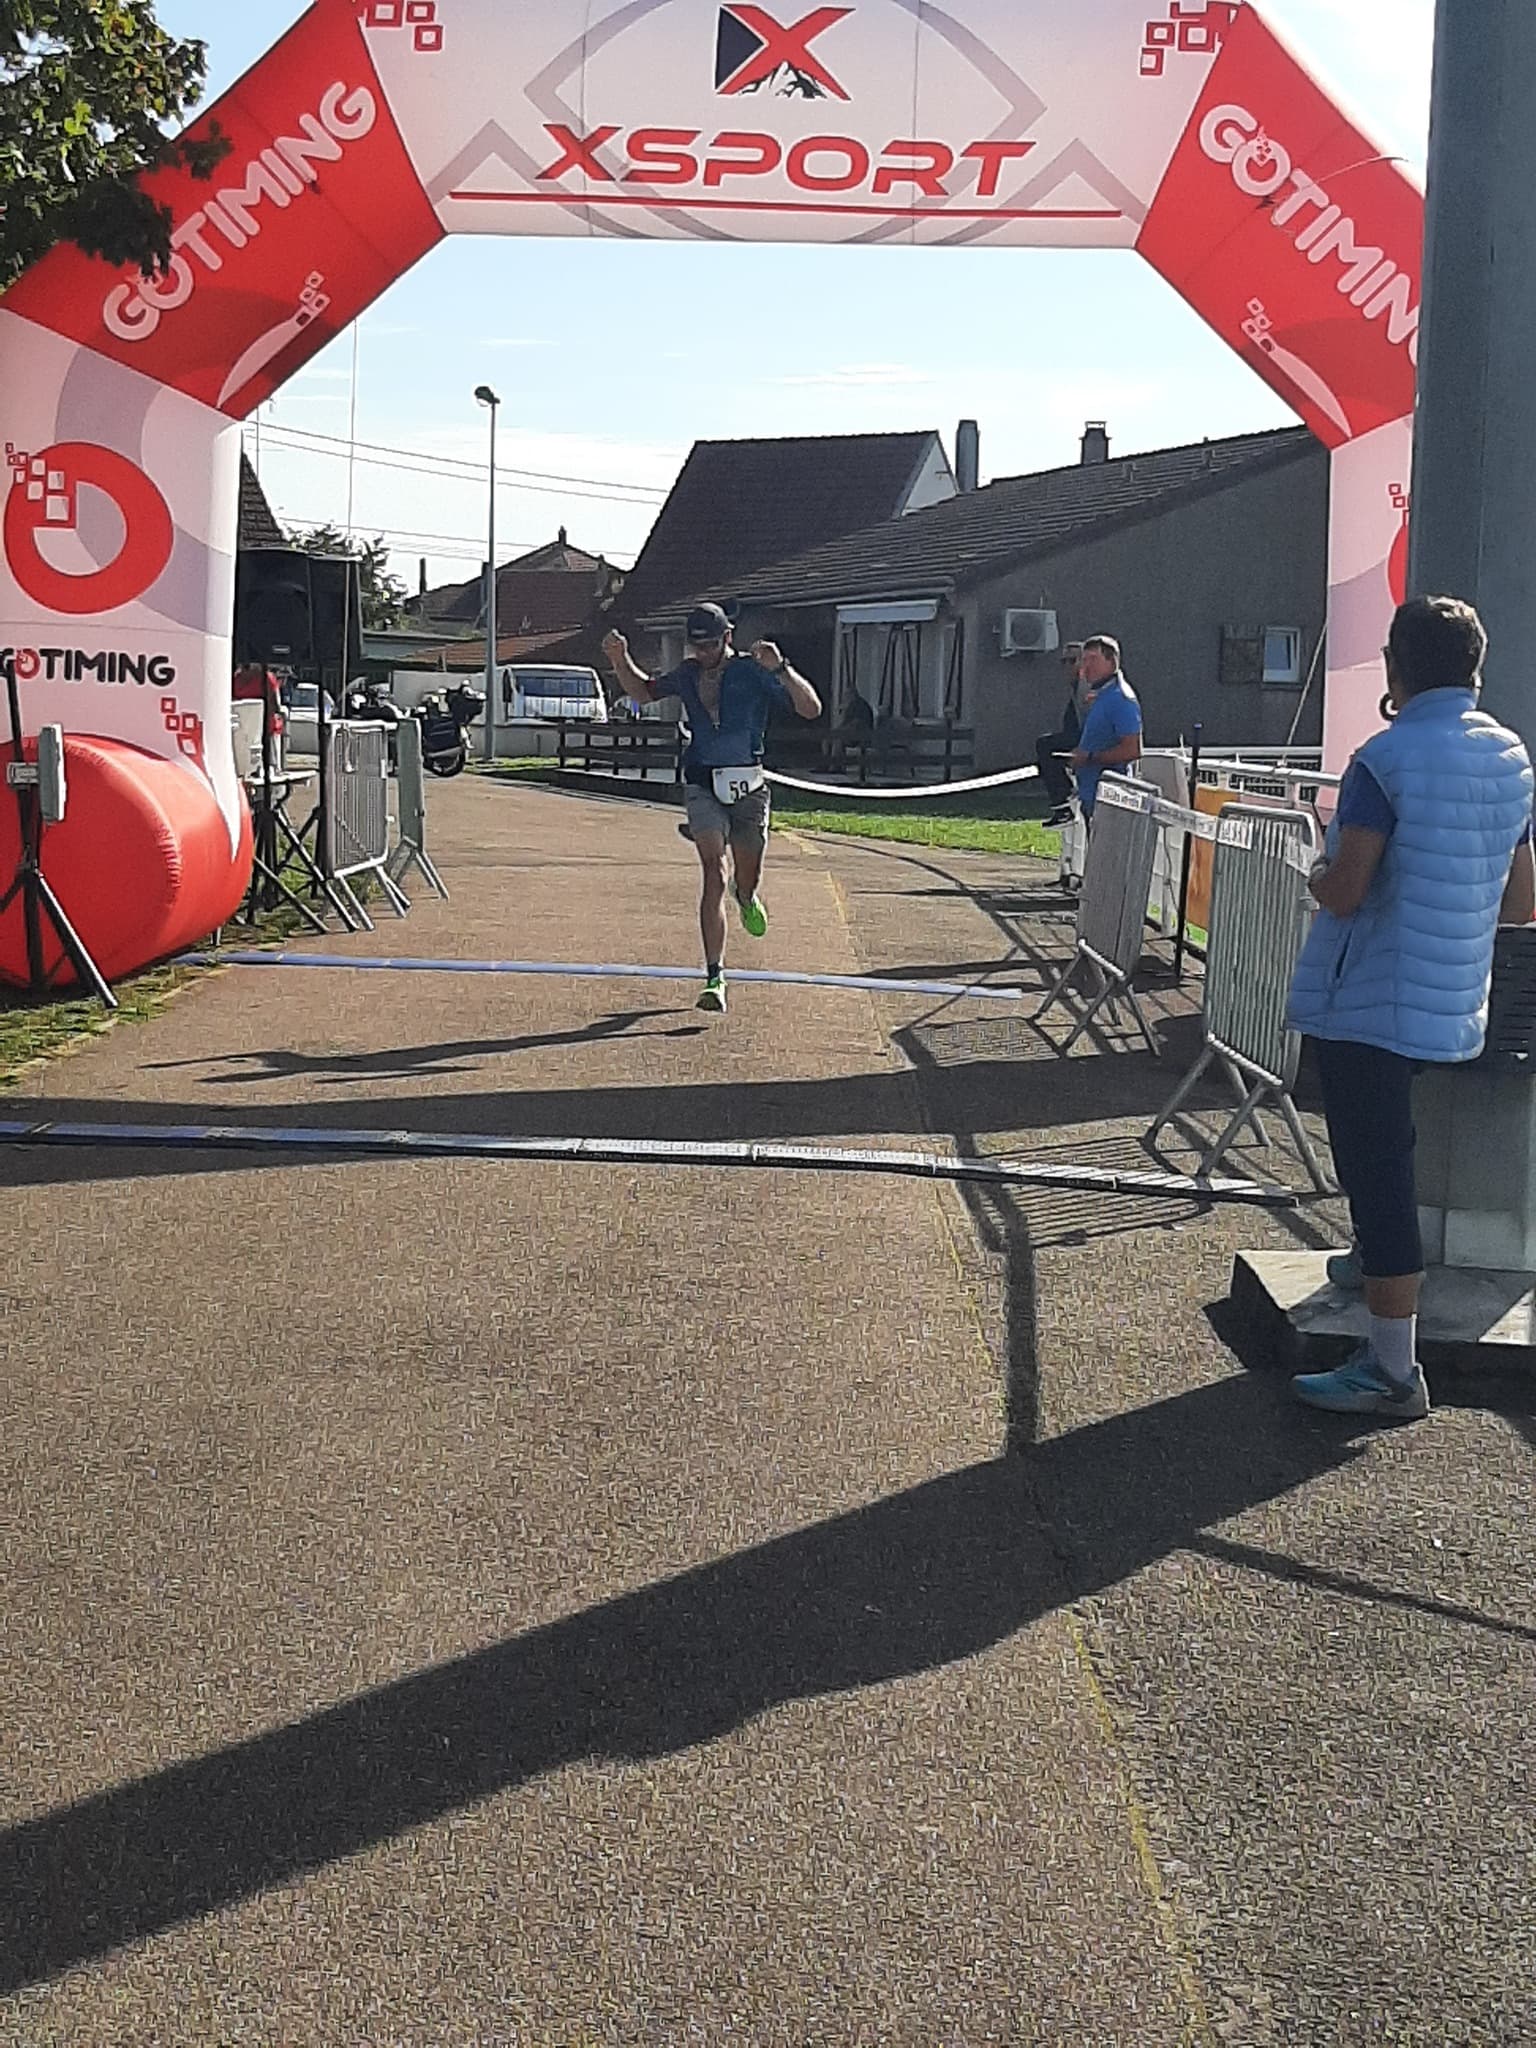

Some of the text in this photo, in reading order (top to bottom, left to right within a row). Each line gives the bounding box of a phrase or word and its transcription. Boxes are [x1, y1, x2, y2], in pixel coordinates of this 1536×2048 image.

[103, 81, 376, 341] GOTIMING
[535, 124, 1037, 197] XSPORT
[1200, 104, 1418, 366] GOTIMIN
